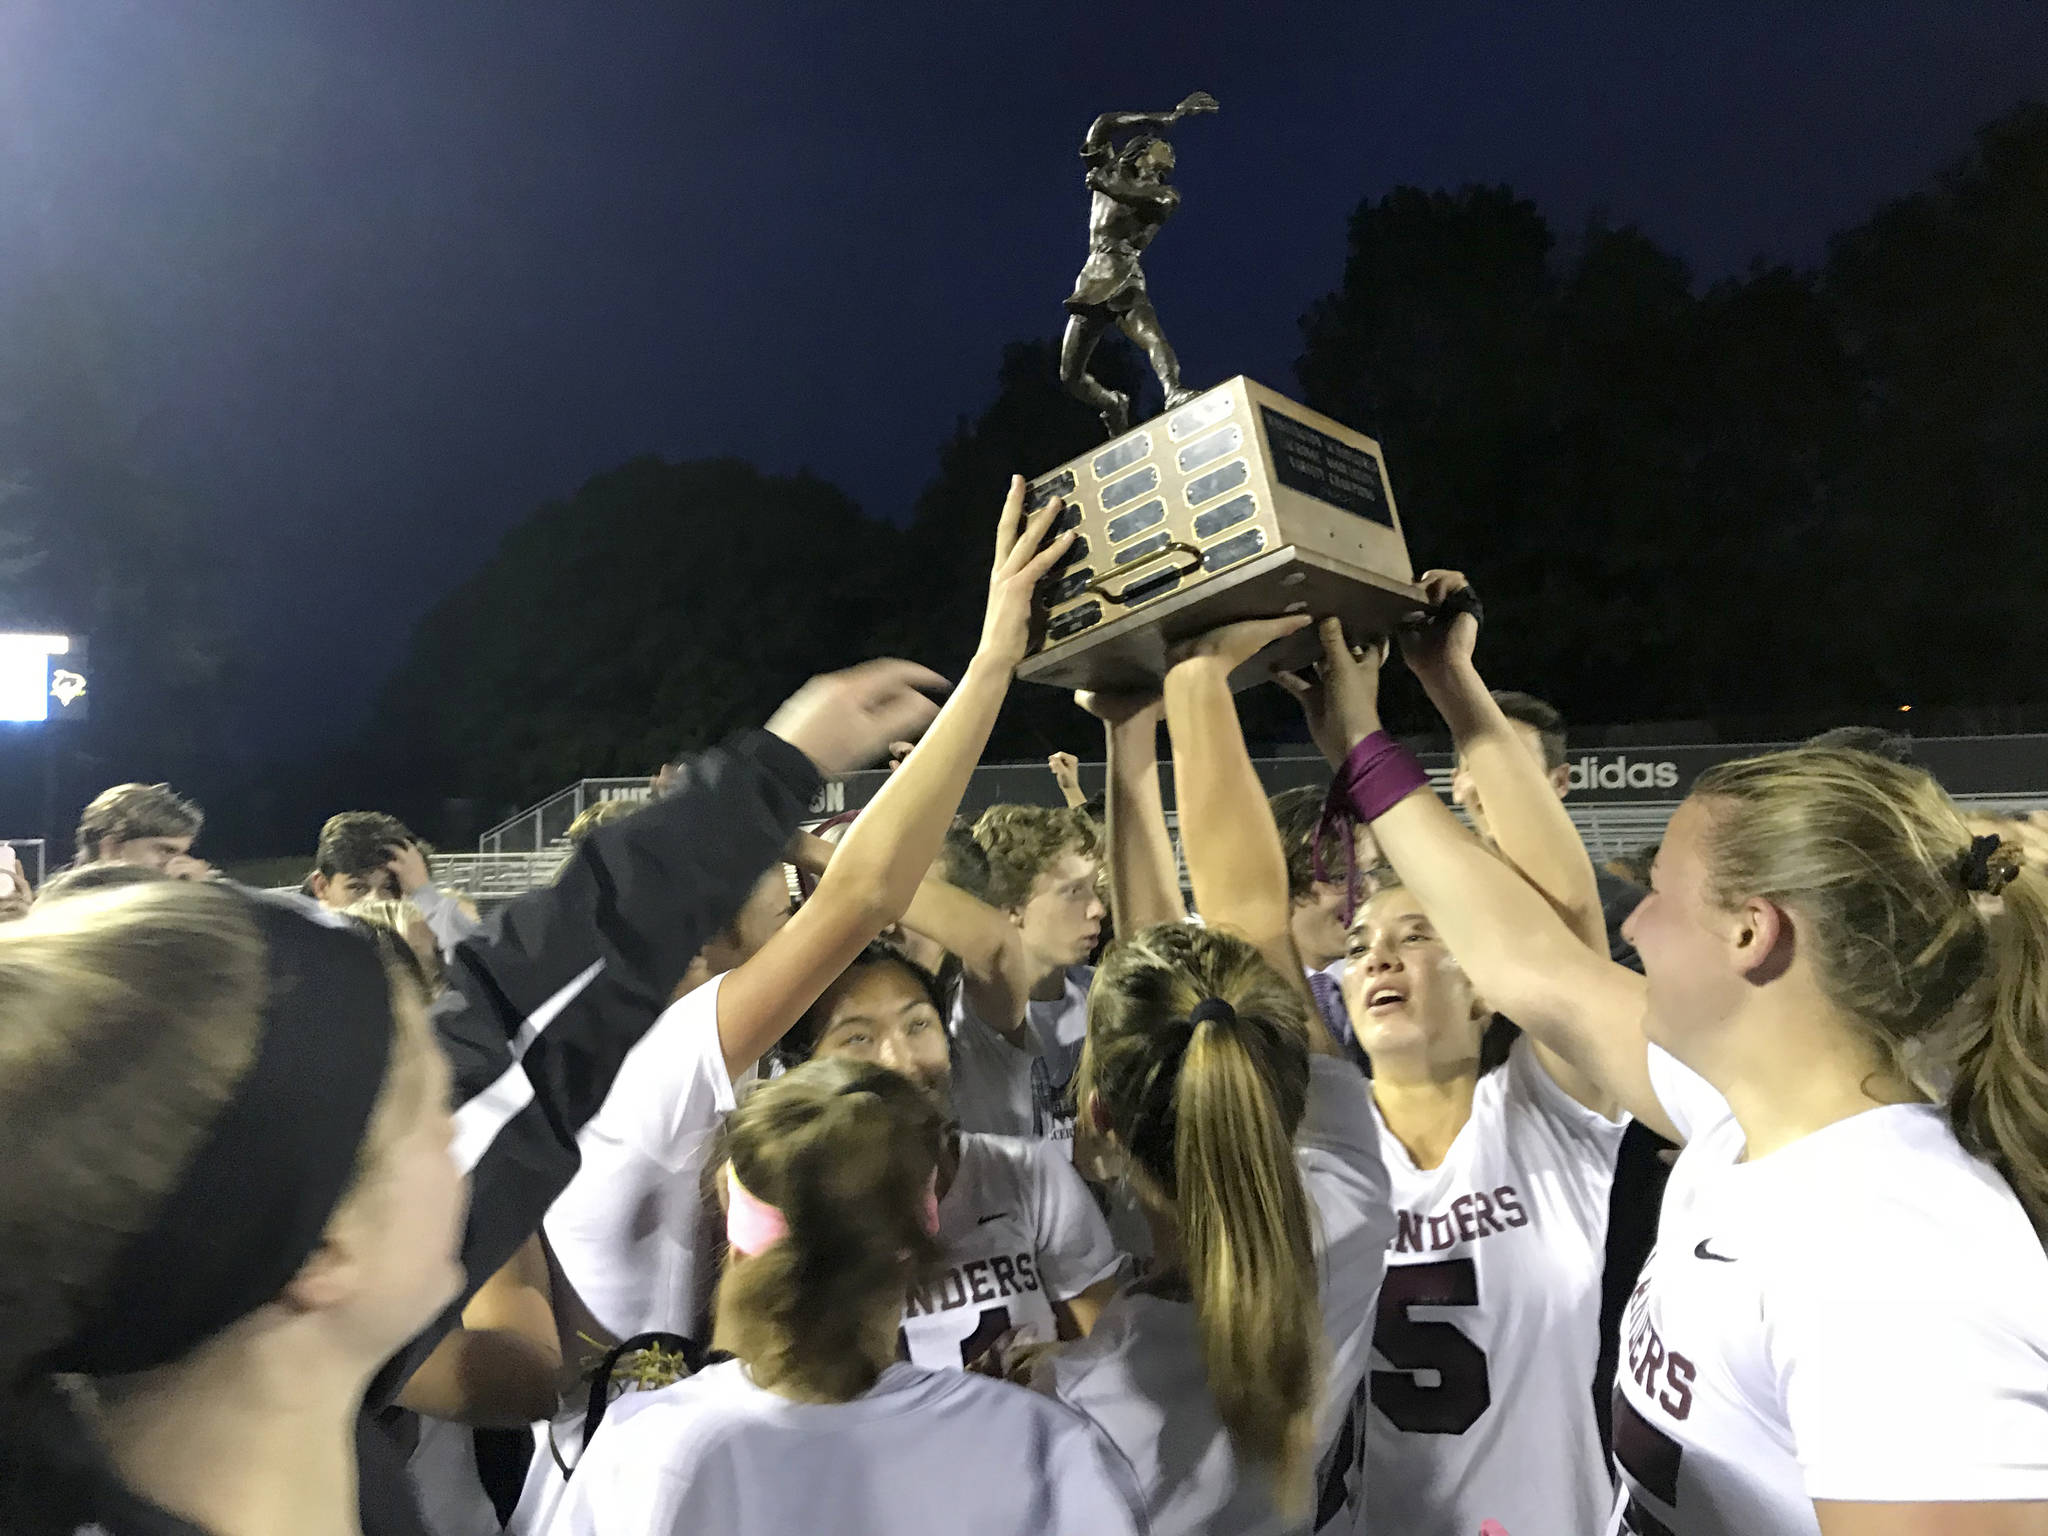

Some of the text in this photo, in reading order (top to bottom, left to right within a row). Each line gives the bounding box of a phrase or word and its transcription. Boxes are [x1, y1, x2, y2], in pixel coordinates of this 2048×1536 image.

[1567, 755, 1679, 789] didas
[1391, 1185, 1528, 1253] NDERS
[1370, 1257, 1491, 1435] 5
